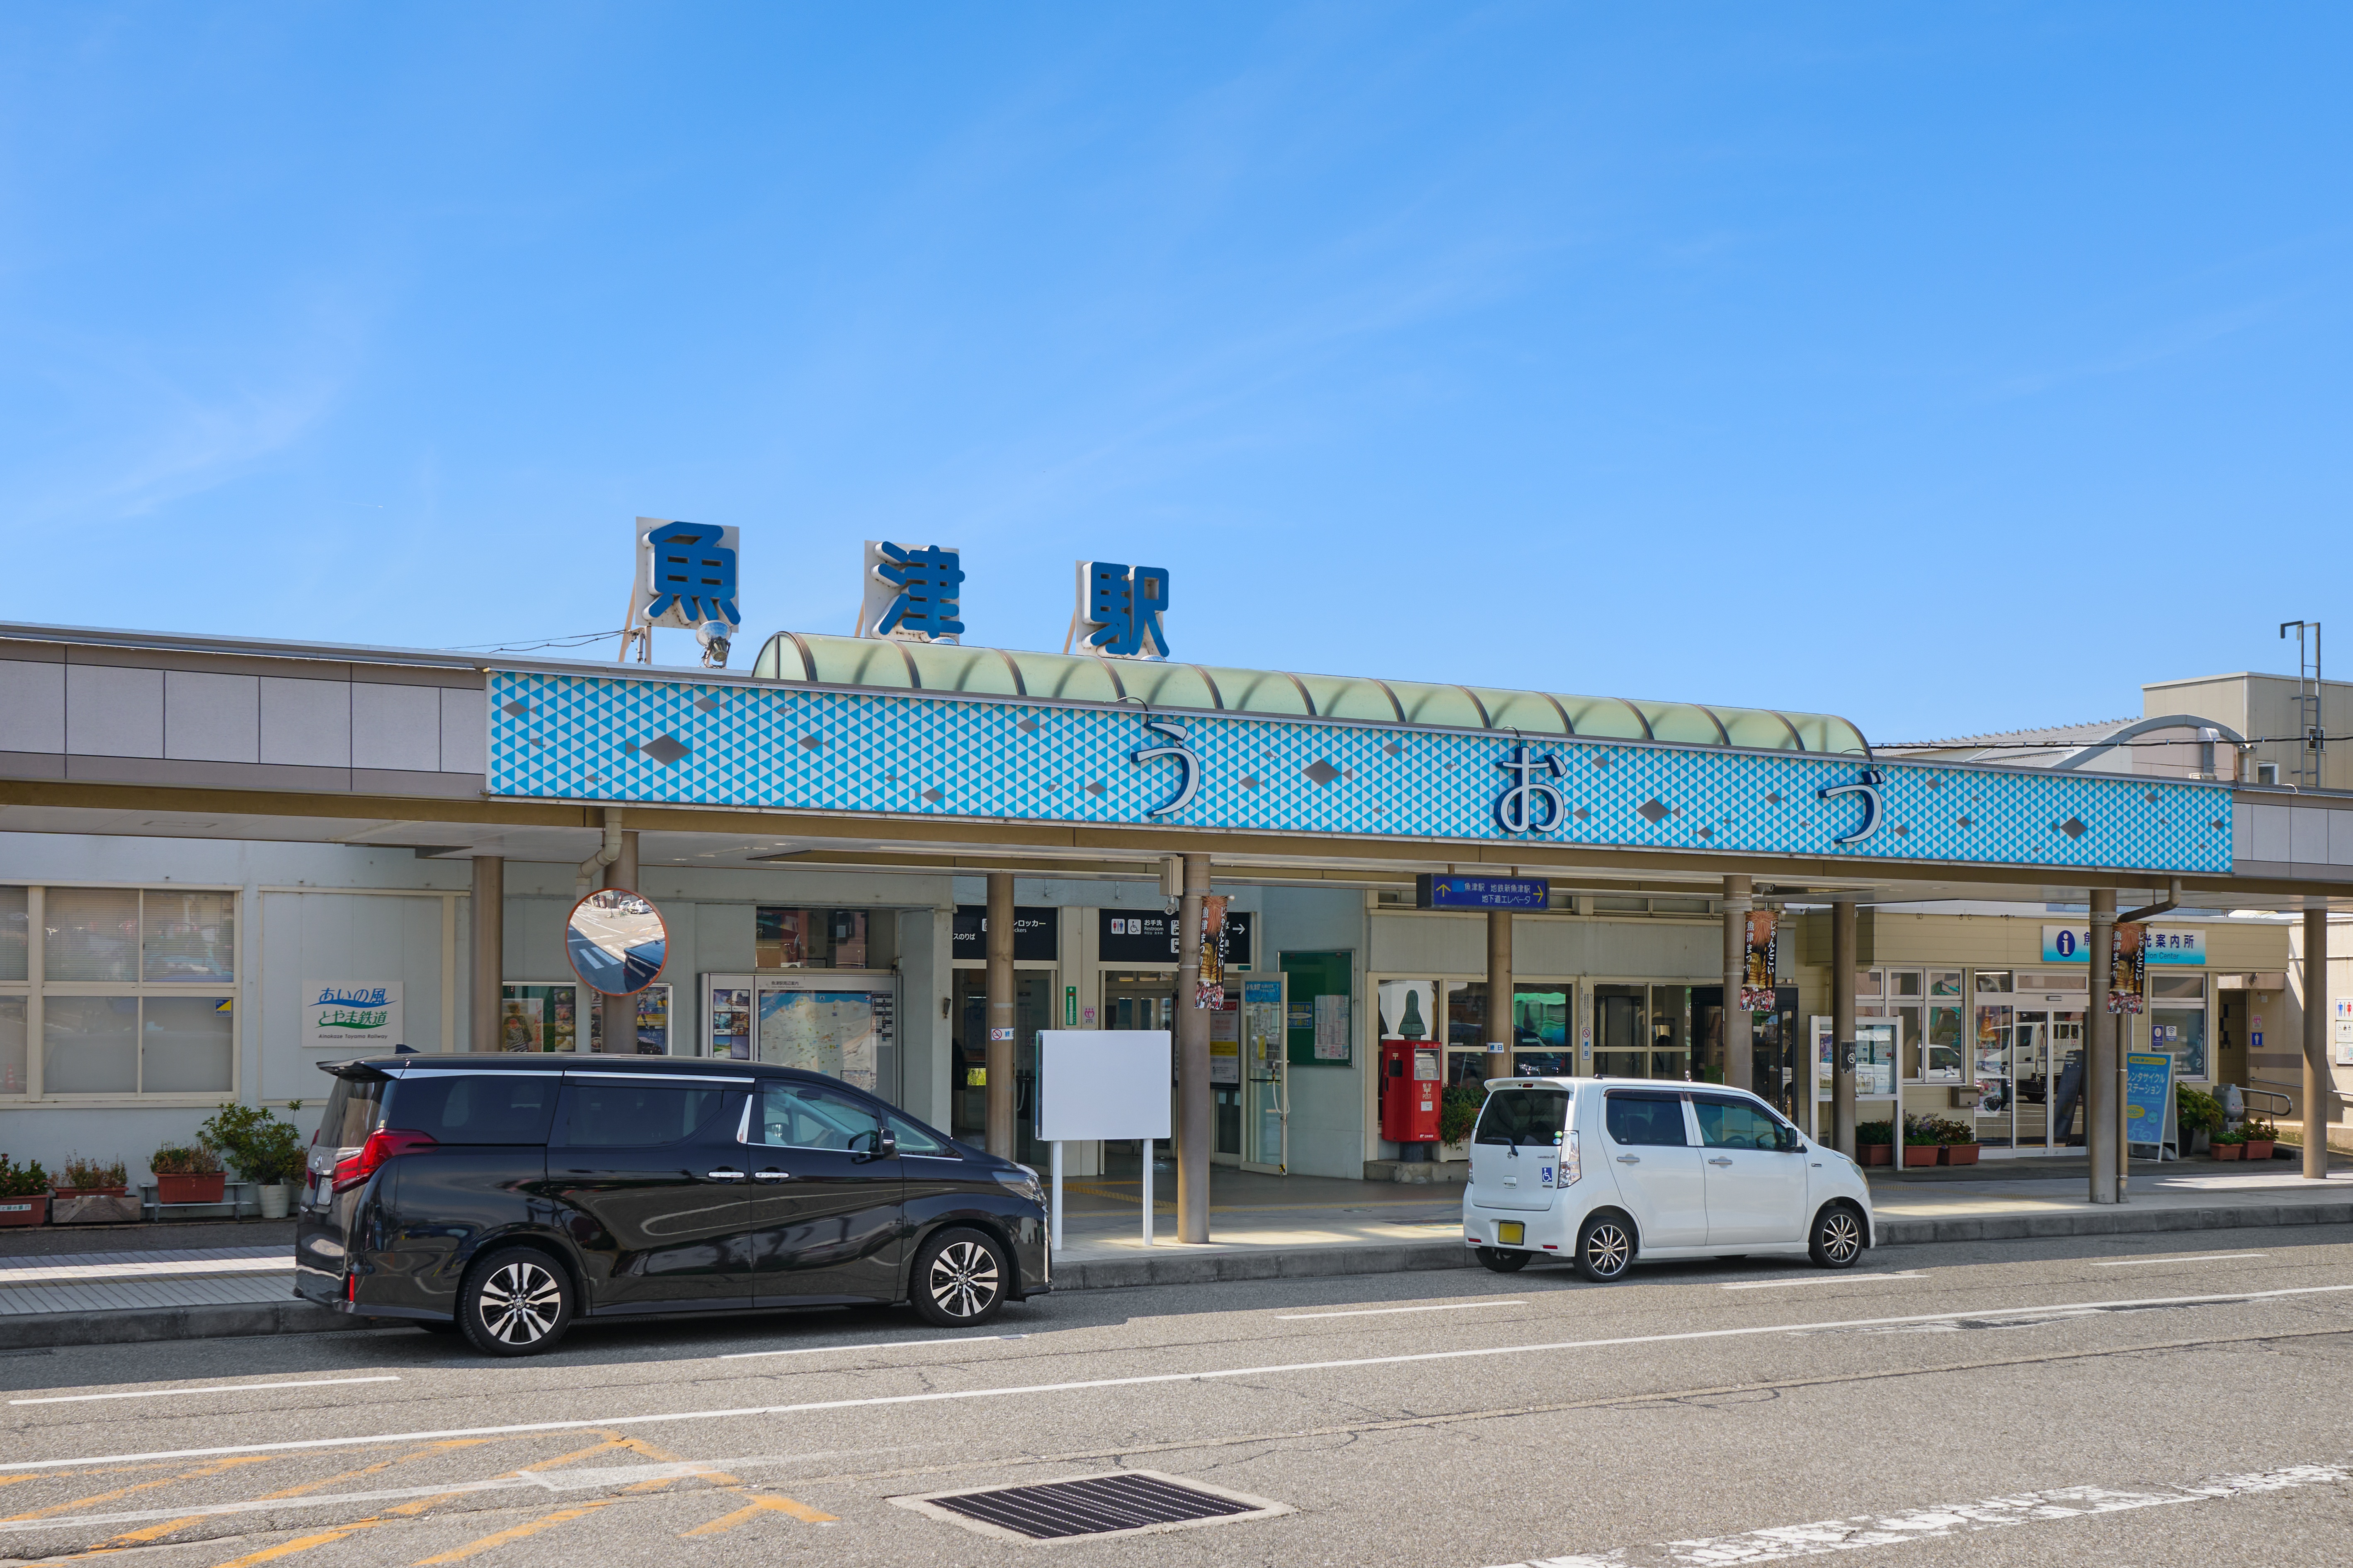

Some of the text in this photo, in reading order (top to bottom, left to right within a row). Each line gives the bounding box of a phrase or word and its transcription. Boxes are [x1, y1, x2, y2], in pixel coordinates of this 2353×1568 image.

[1464, 882, 1531, 893] 魚津駅 地鉄新魚津駅
[1482, 894, 1531, 904] 地下道エレベータ
[1199, 906, 1209, 967] 魚津まつり
[1218, 906, 1226, 967] じゃんとこい
[1746, 921, 1754, 974] 魚津まつり
[1767, 921, 1776, 974] じゃんとこい
[2112, 931, 2122, 979] 魚津まつり
[2135, 931, 2144, 981] じゃんとこい
[318, 1010, 388, 1025] とやま鉄道
[319, 988, 388, 1003] あいの風
[2127, 1083, 2162, 1094] ステーション
